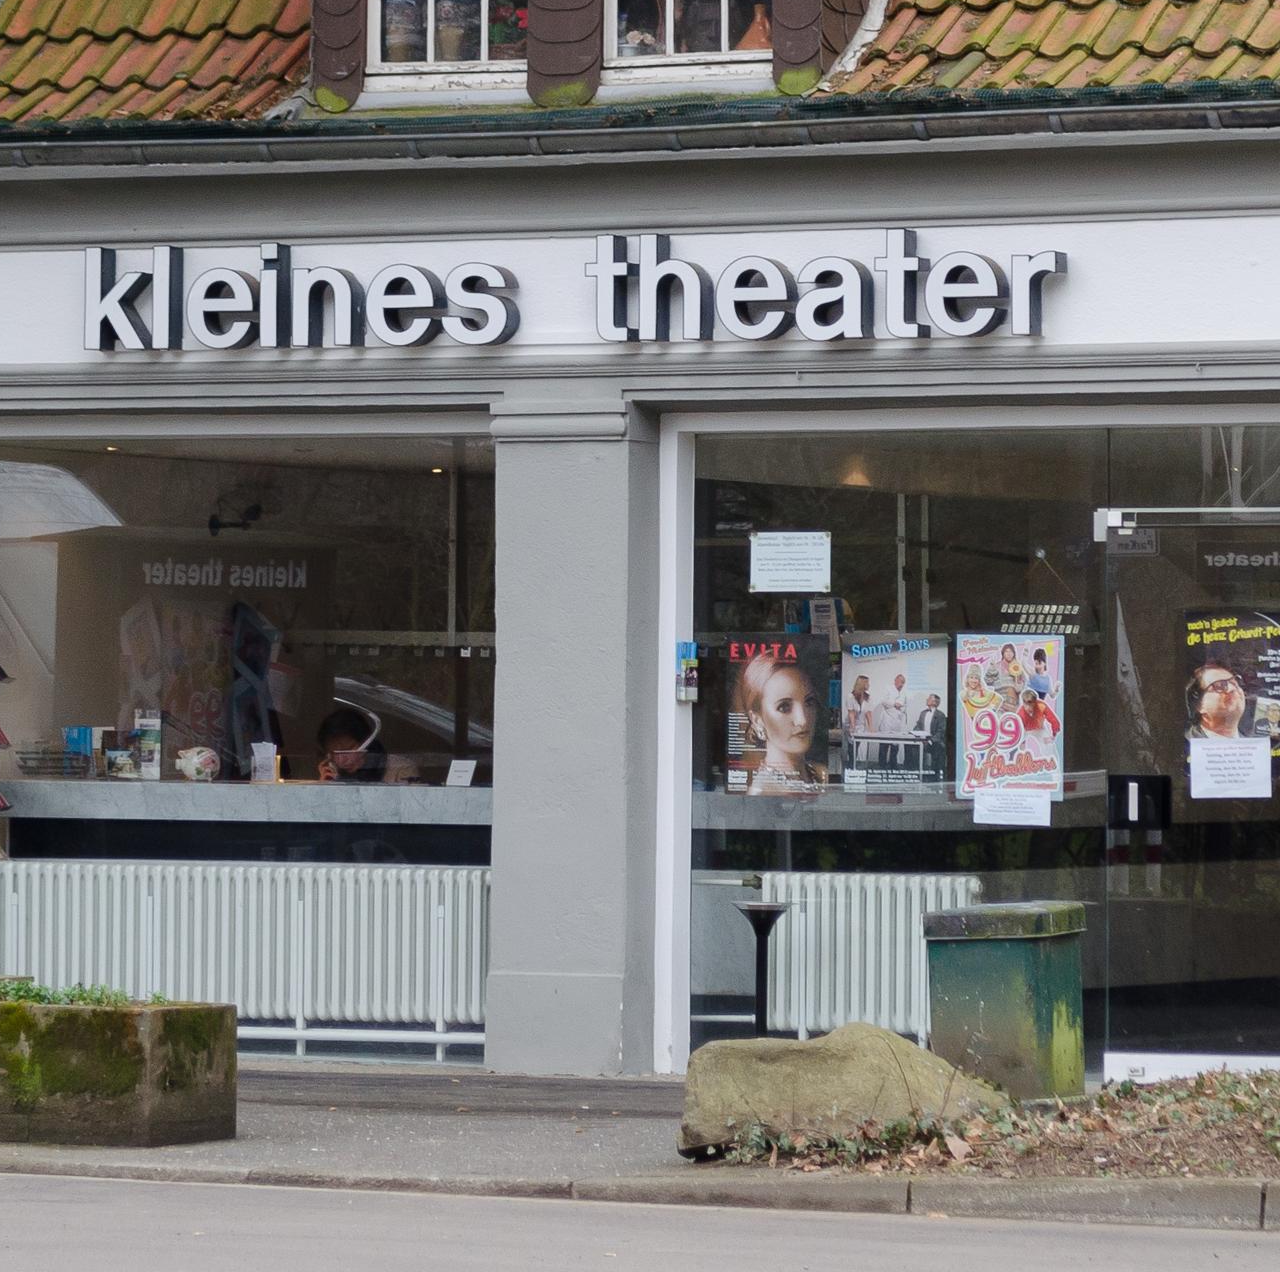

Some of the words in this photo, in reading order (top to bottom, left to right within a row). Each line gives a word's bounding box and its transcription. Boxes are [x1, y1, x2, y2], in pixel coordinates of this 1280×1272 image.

[83, 243, 520, 351] kleines
[584, 227, 1068, 343] theater
[729, 642, 797, 659] EVITA
[851, 643, 893, 659] Sonny
[897, 638, 930, 653] Boys
[970, 711, 1022, 751] 99
[963, 748, 1057, 794] Luftballons
